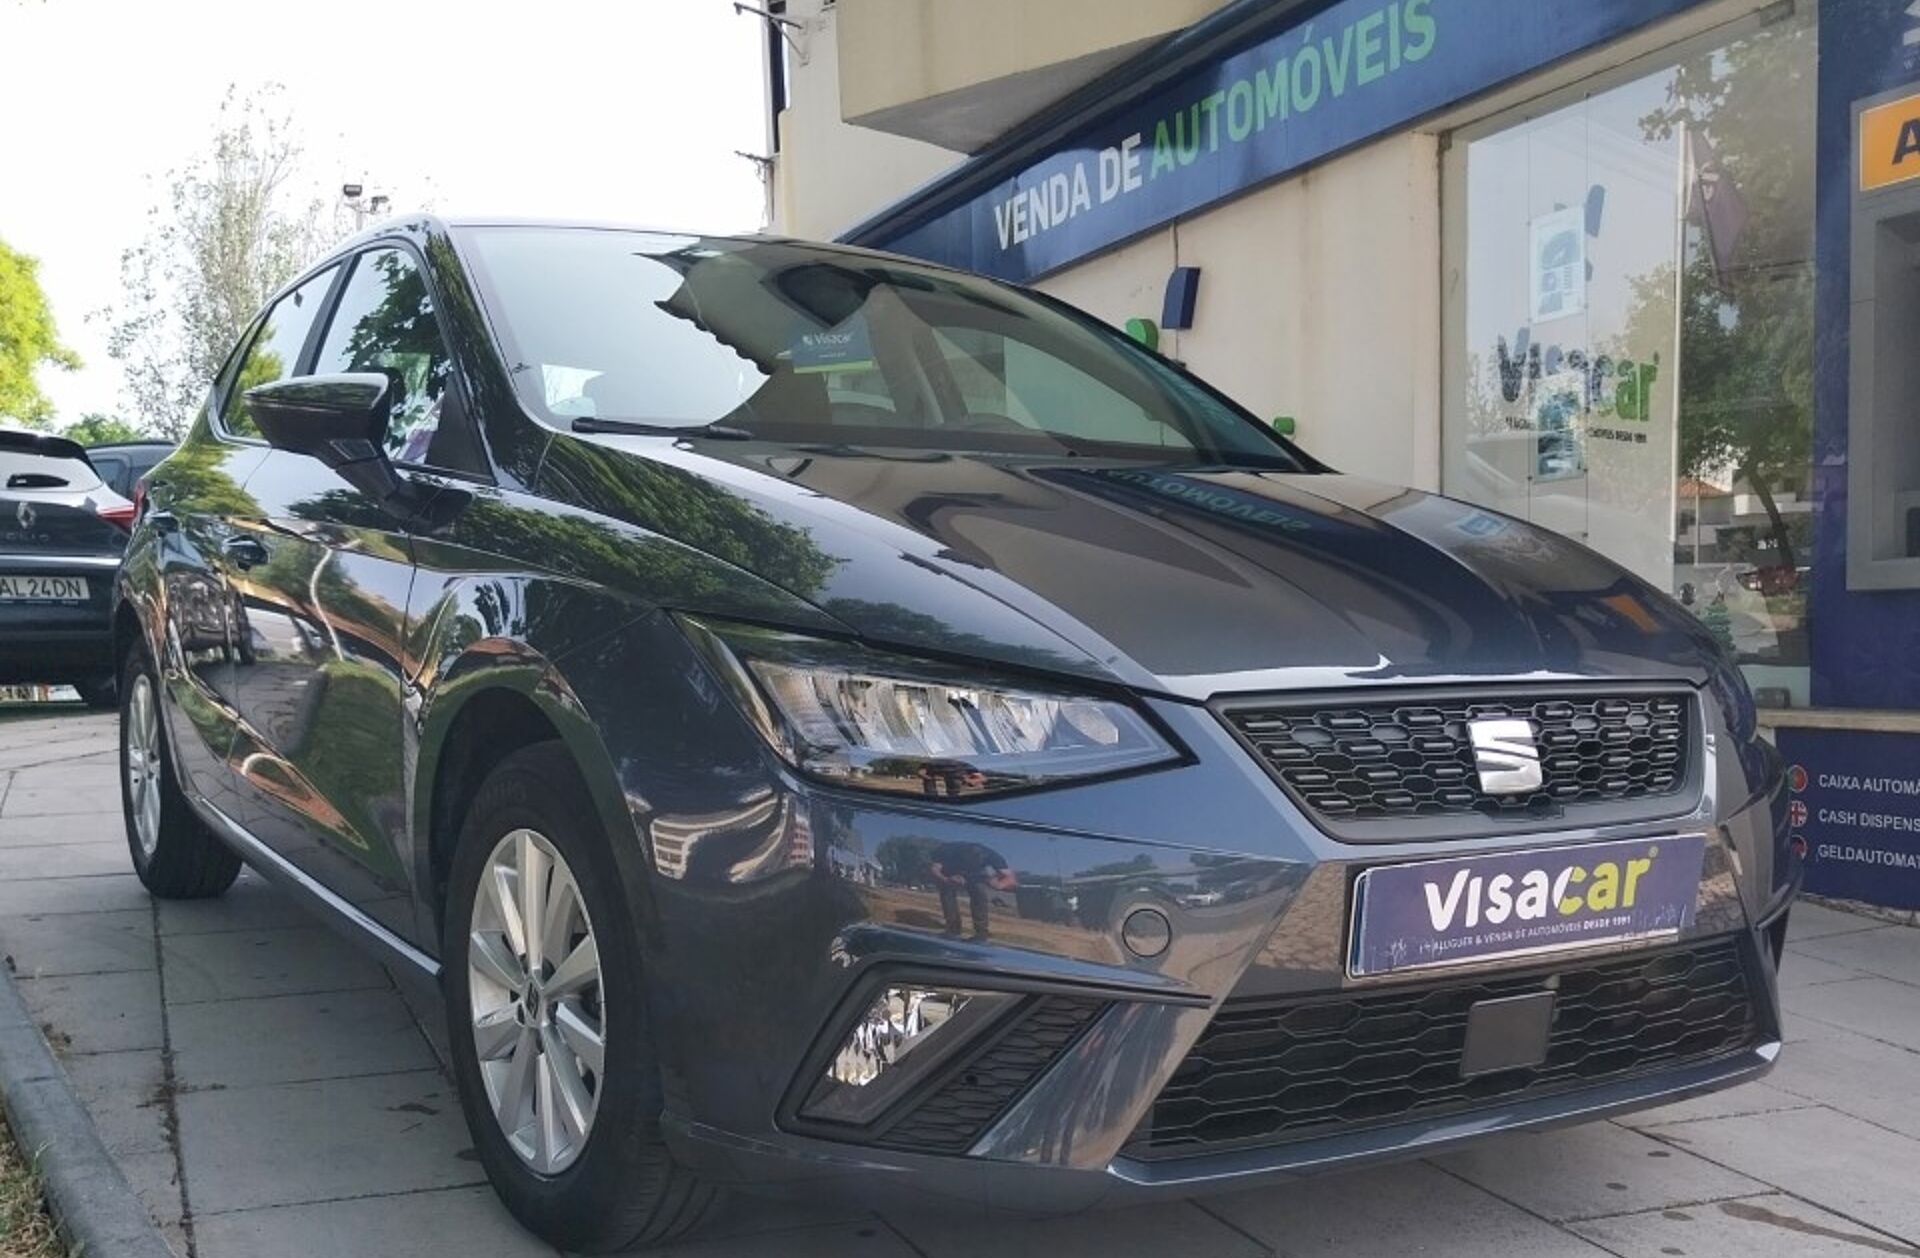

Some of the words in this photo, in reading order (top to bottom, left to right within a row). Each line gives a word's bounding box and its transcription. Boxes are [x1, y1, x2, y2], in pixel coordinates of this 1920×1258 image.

[994, 162, 1091, 250] VENDA
[1100, 132, 1143, 204] DE
[1149, 0, 1437, 181] AUTOMÓVEIS
[1818, 774, 1861, 790] CAIXA
[1818, 808, 1857, 826] CASH
[1860, 812, 1920, 832] DISPENS
